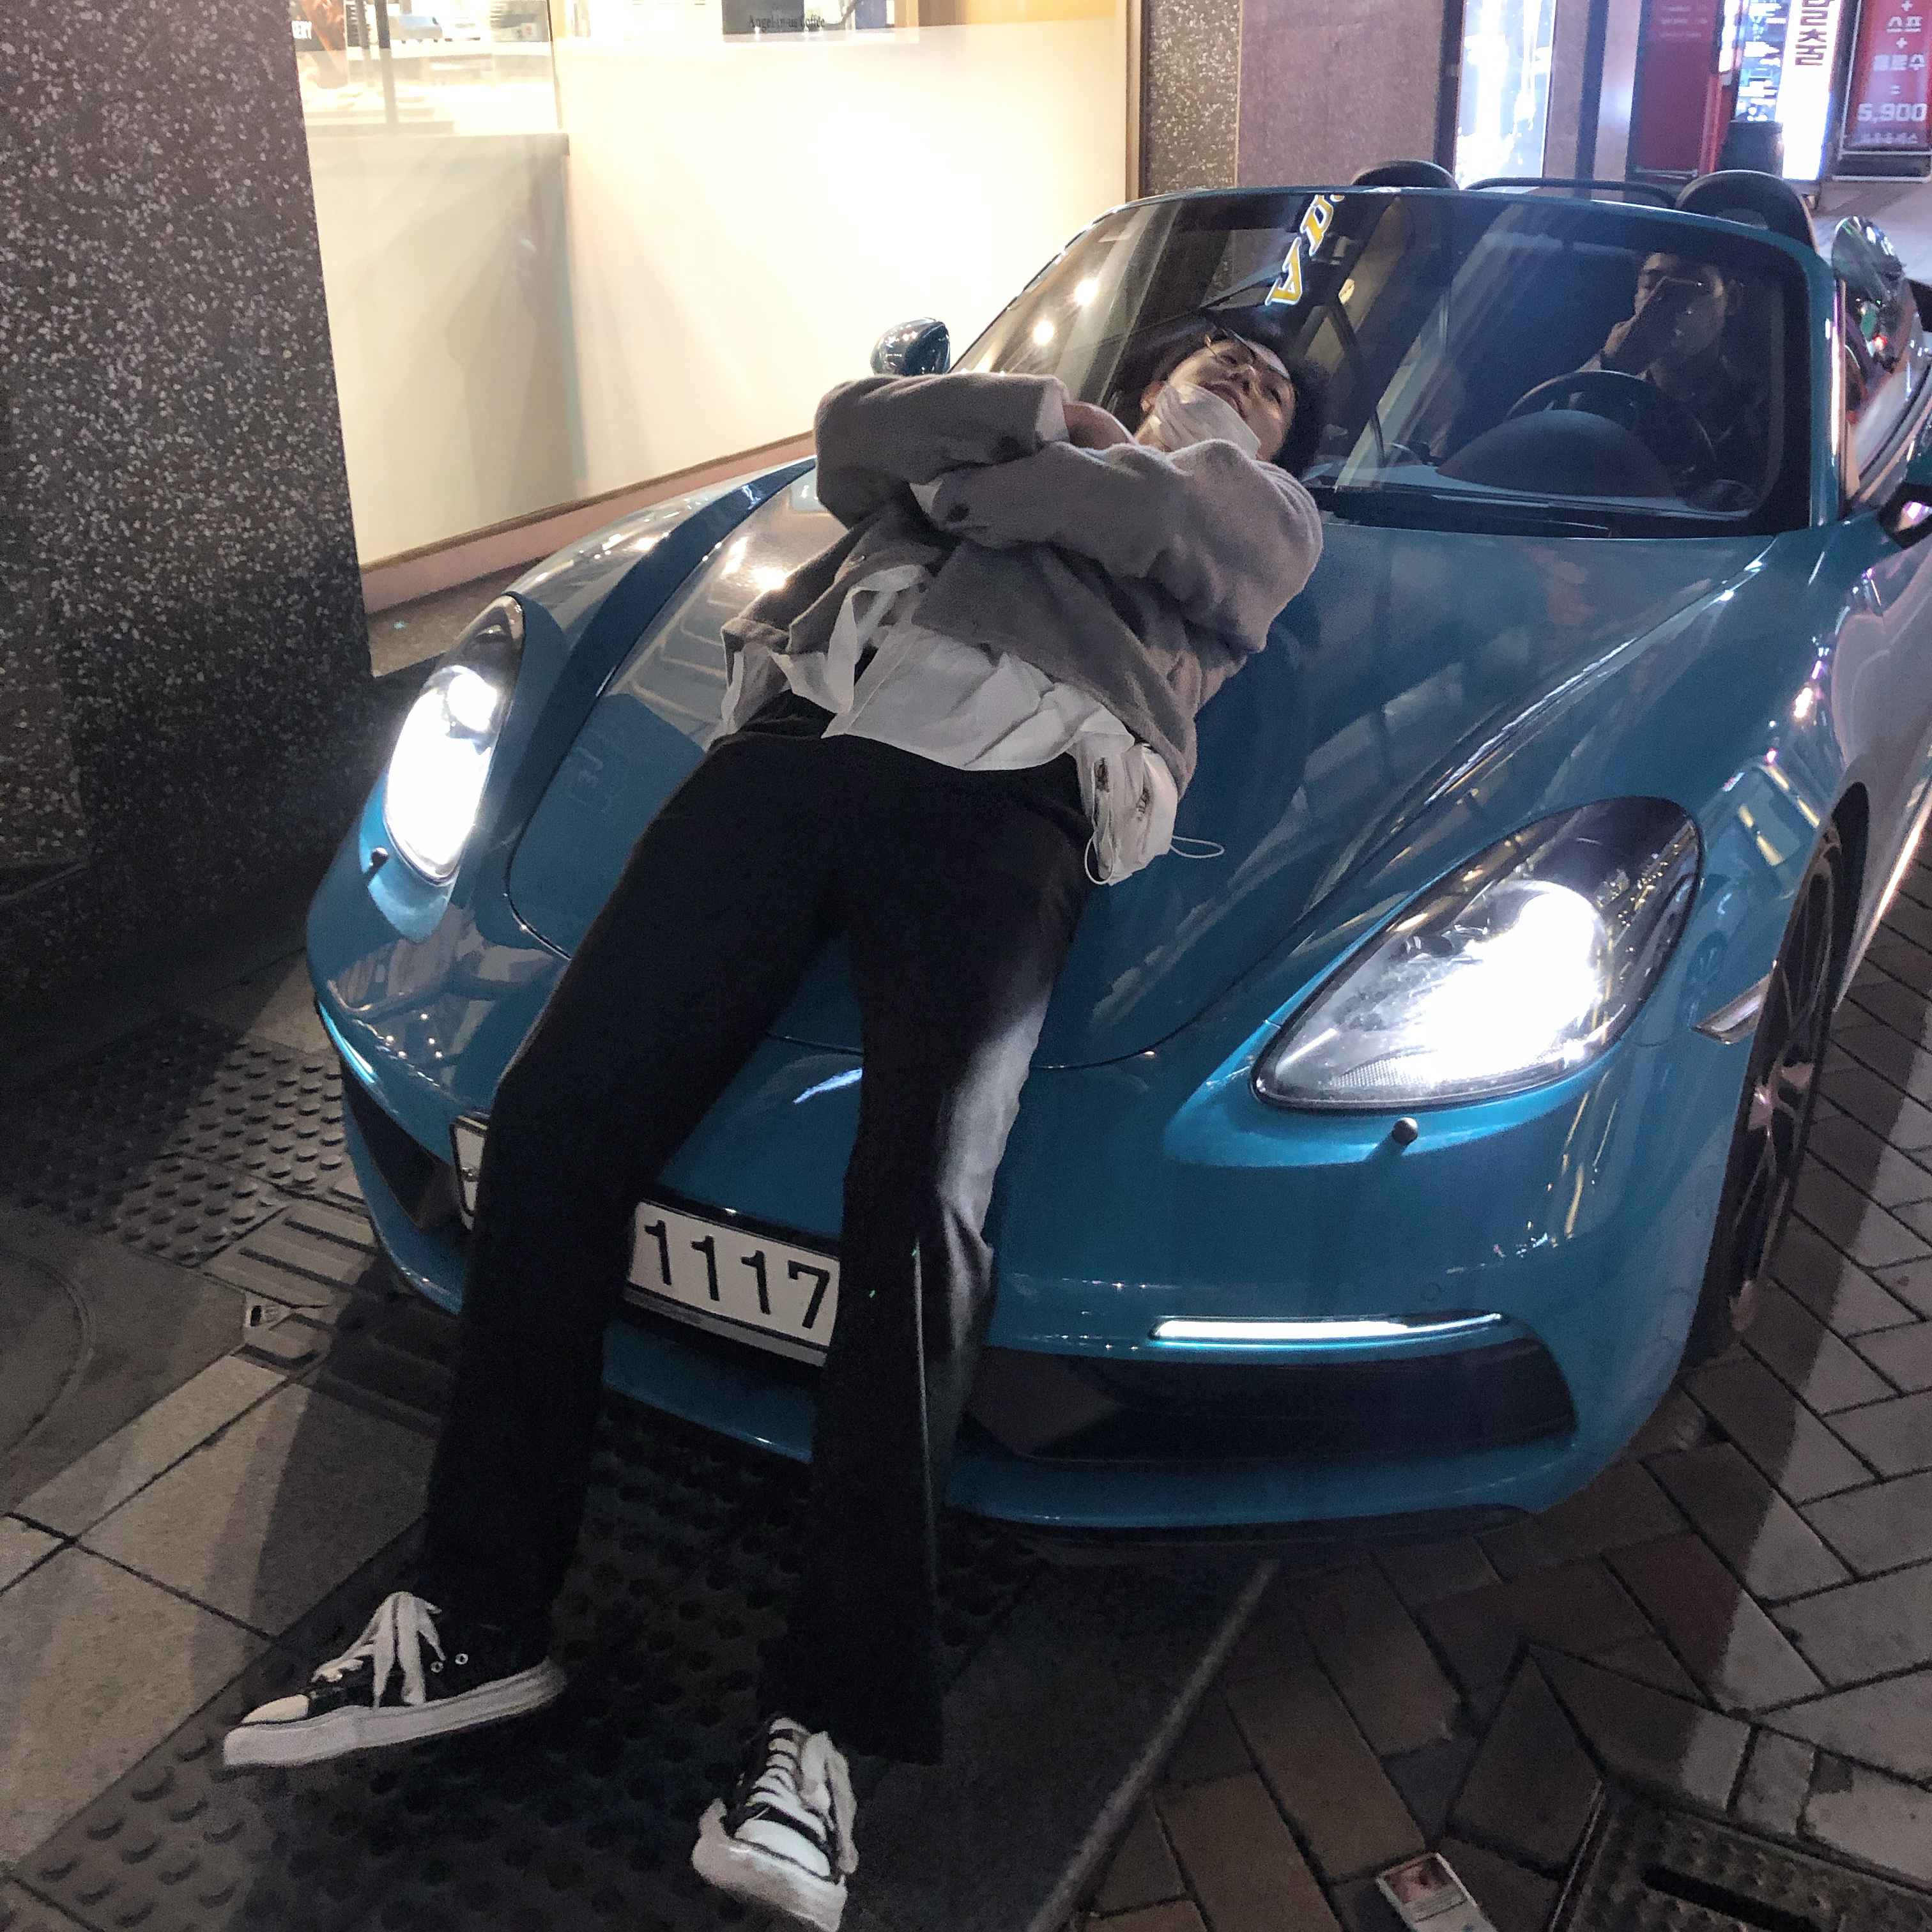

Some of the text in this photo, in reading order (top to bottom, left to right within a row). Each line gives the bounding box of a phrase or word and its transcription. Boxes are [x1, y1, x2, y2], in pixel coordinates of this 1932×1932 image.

[1887, 16, 1922, 33] 스프
[1858, 103, 1928, 123] 5,900
[645, 1220, 830, 1329] 1117
